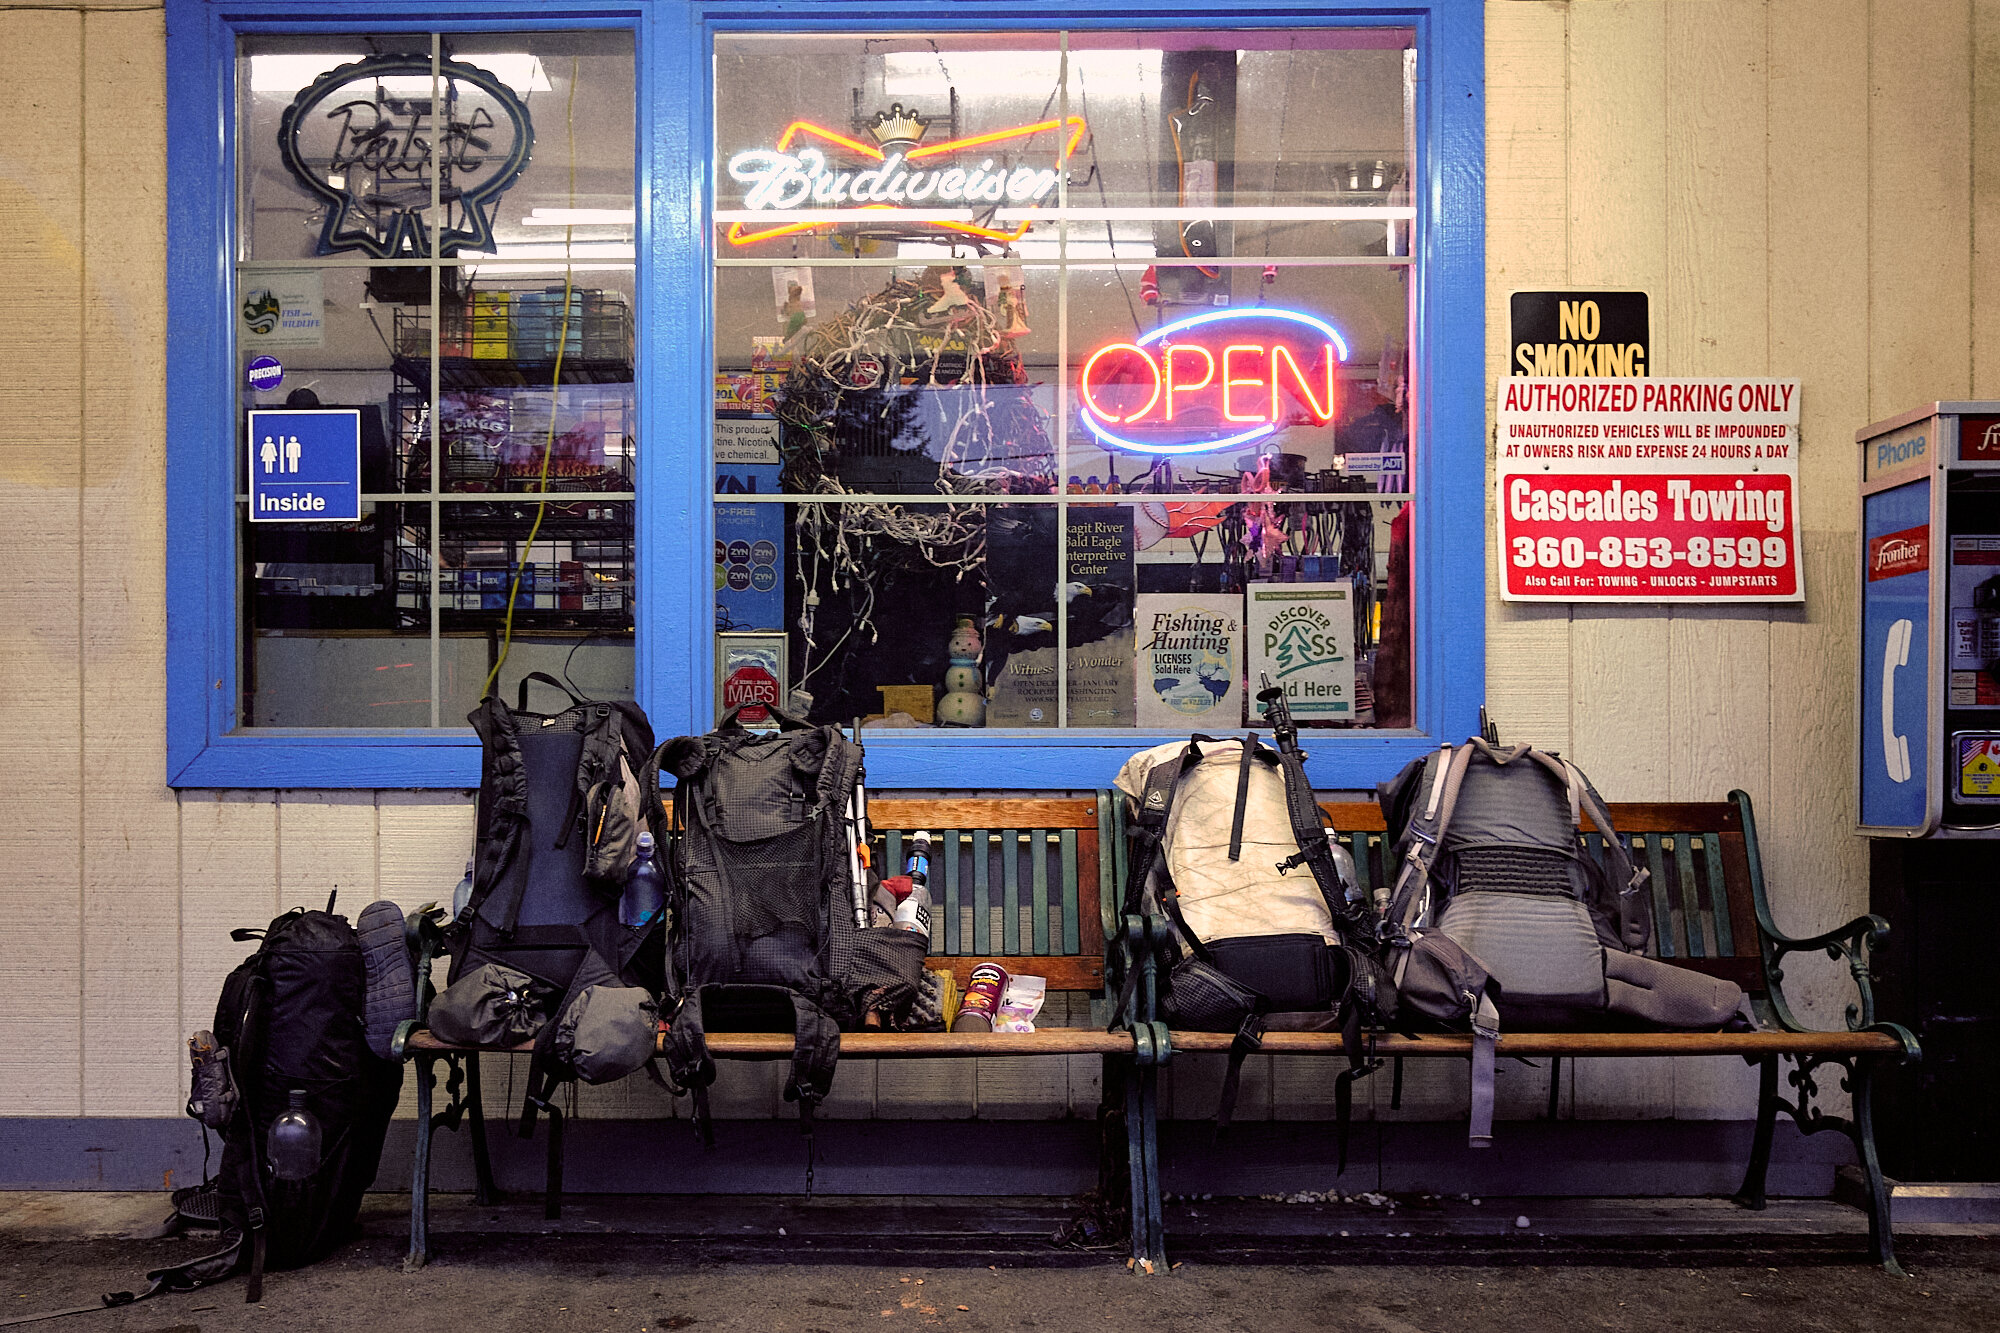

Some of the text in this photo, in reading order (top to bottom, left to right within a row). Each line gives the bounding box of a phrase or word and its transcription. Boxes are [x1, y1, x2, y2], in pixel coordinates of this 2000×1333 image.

[728, 149, 1069, 210] Budweiser
[1559, 300, 1601, 341] NO
[1515, 343, 1645, 377] SMOKING
[249, 365, 281, 382] PRECISION
[1082, 343, 1334, 424] OPEN
[1505, 384, 1793, 412] AUTHORIZED PARKING ONLY
[716, 424, 769, 435] This product
[1509, 424, 1786, 438] UNAUTHORIZED VEHICLES WILL BE IMPOUNDED
[716, 437, 774, 446] tine. Nicotine
[728, 450, 769, 459] chemical.
[1506, 444, 1789, 458] AT OWNERS RISK AND EXPENSE 24 HOURS A DAY
[1877, 436, 1926, 469] Phone
[1383, 459, 1402, 468] ADT
[260, 492, 325, 511] Inside
[1511, 479, 1784, 532] Cascades Towing
[715, 508, 756, 516] O-FREE
[1066, 522, 1124, 536] kagit River
[1091, 535, 1122, 550] Eagle
[730, 548, 748, 556] ZYN
[1066, 550, 1126, 564] nterpretive
[1512, 536, 1786, 568] 360-853-8599
[1875, 539, 1920, 571] frontier
[1071, 564, 1108, 575] Center
[1525, 575, 1546, 586] Also
[1550, 575, 1570, 586] Call
[1574, 575, 1594, 586] For:
[1598, 575, 1638, 586] TOWING
[1650, 575, 1697, 586] UNLOCKS
[1709, 575, 1777, 586] JUMPSTARTS
[1152, 613, 1238, 636] Fishing &
[1268, 606, 1330, 631] DISCOVER
[1151, 632, 1230, 654] Hunting
[1009, 663, 1054, 675] Witness
[1079, 656, 1122, 667] Wonder
[1154, 654, 1192, 664] LICENSES
[1155, 665, 1191, 674] Sold Here
[728, 685, 774, 702] MAPS
[1282, 682, 1341, 696] ld Here
